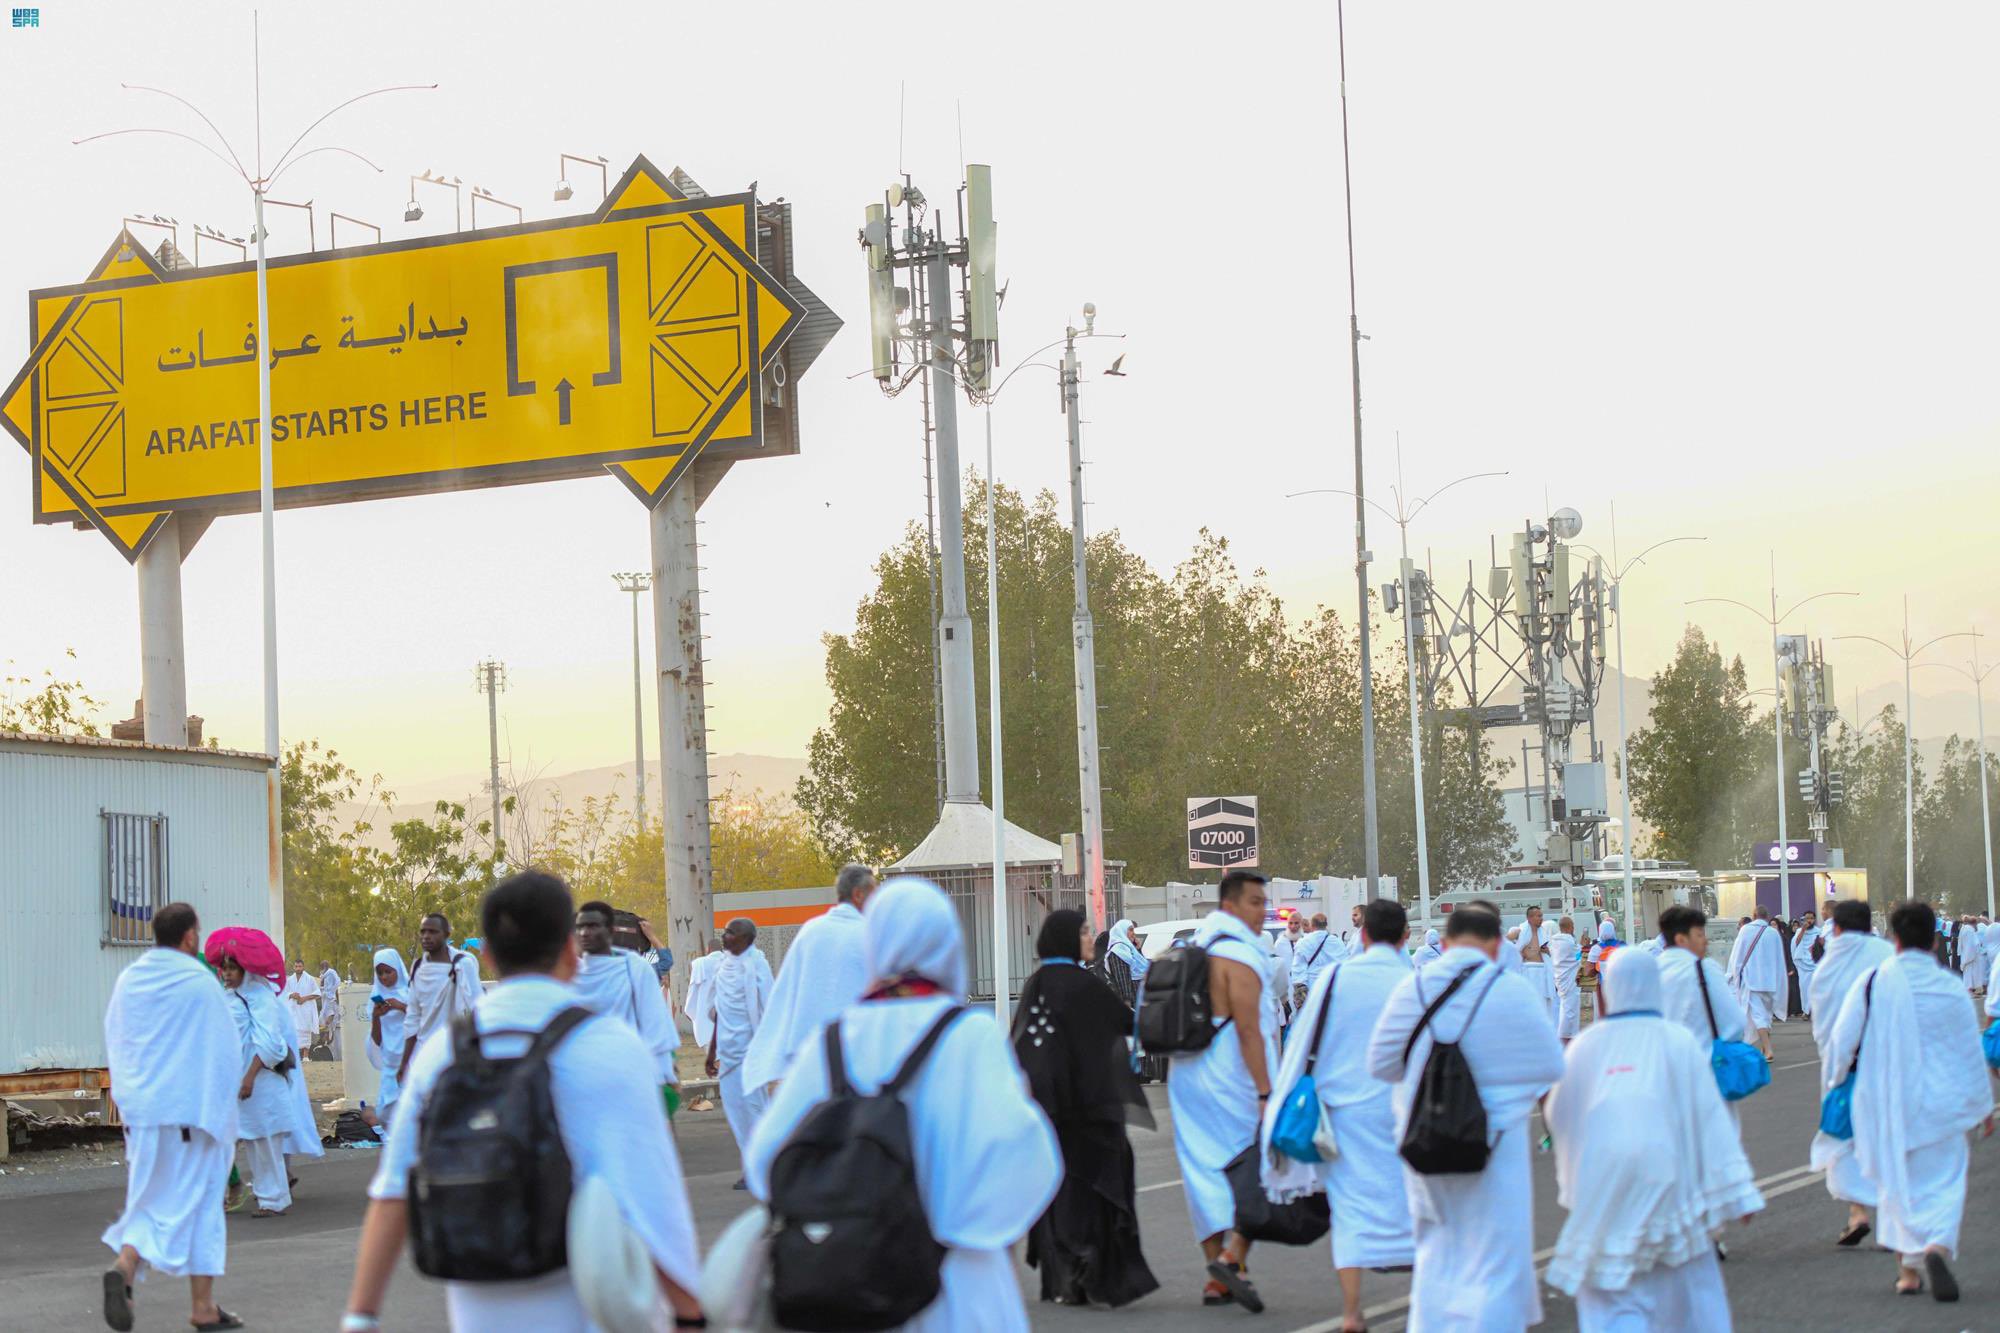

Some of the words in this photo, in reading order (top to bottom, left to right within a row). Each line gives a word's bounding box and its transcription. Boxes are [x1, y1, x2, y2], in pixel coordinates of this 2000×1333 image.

[158, 321, 322, 372] عرفات
[338, 302, 468, 355] بداية
[145, 418, 260, 456] ARAFAT
[271, 403, 388, 442] STARTS
[400, 391, 488, 427] HERE
[1200, 831, 1245, 845] 07000
